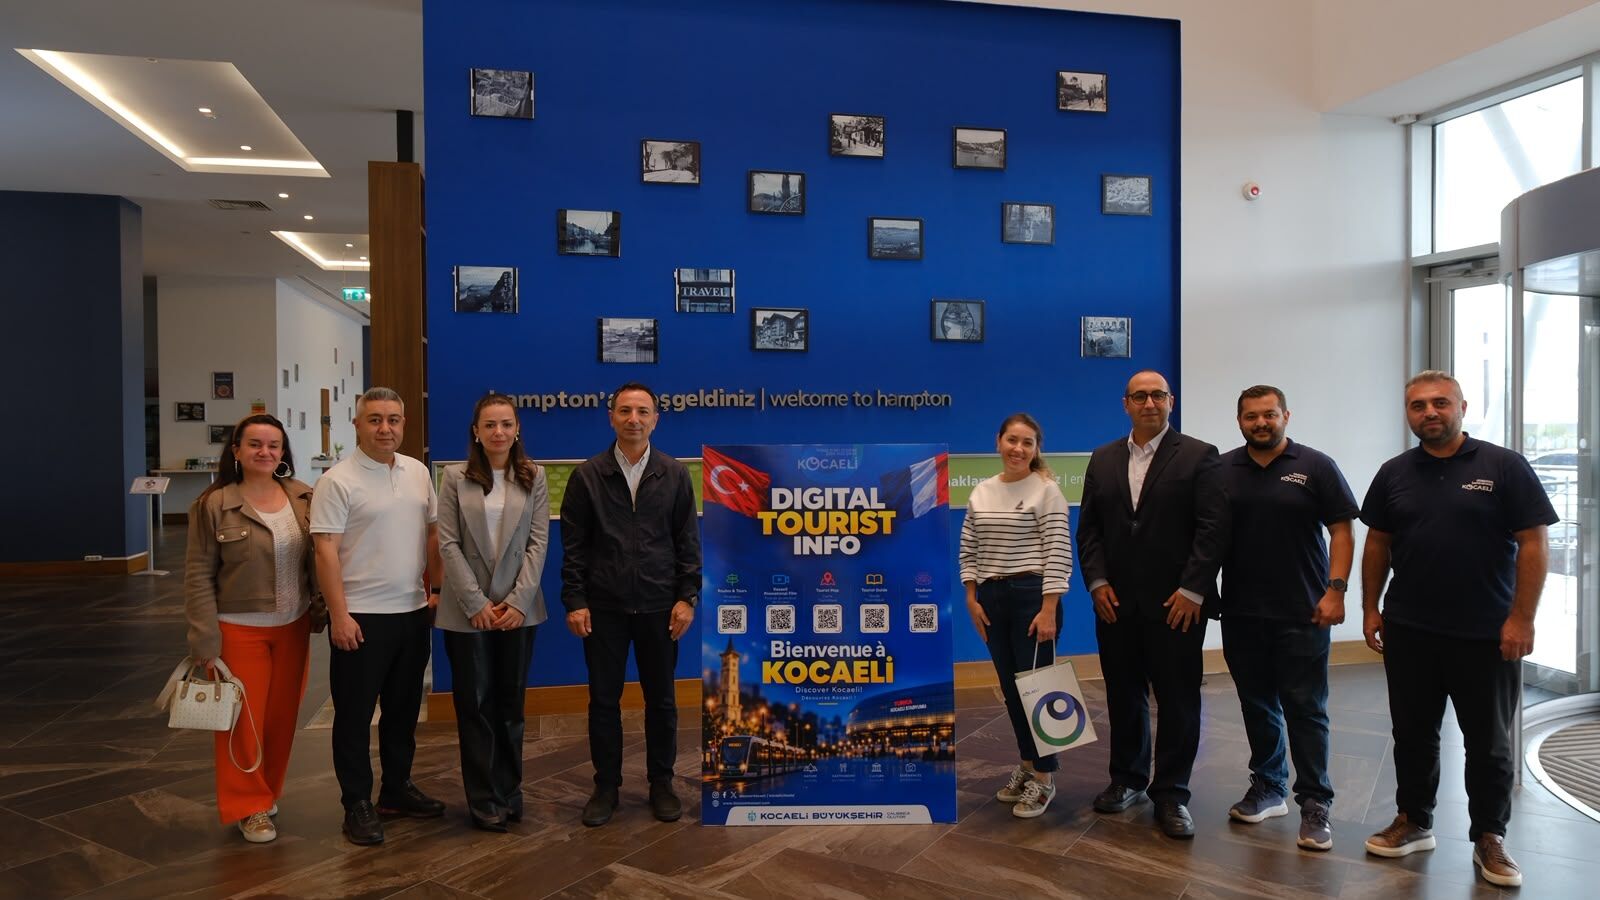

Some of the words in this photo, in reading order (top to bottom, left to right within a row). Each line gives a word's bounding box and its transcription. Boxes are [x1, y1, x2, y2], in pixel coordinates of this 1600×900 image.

[681, 287, 728, 297] TRAVEL
[770, 389, 849, 407] welcome
[852, 391, 873, 407] to
[877, 389, 952, 411] hampton
[771, 487, 886, 510] DIGITAL
[757, 510, 897, 535] TOURIST
[793, 535, 861, 555] INFO
[771, 640, 872, 657] Bienvenue
[875, 640, 886, 657] à
